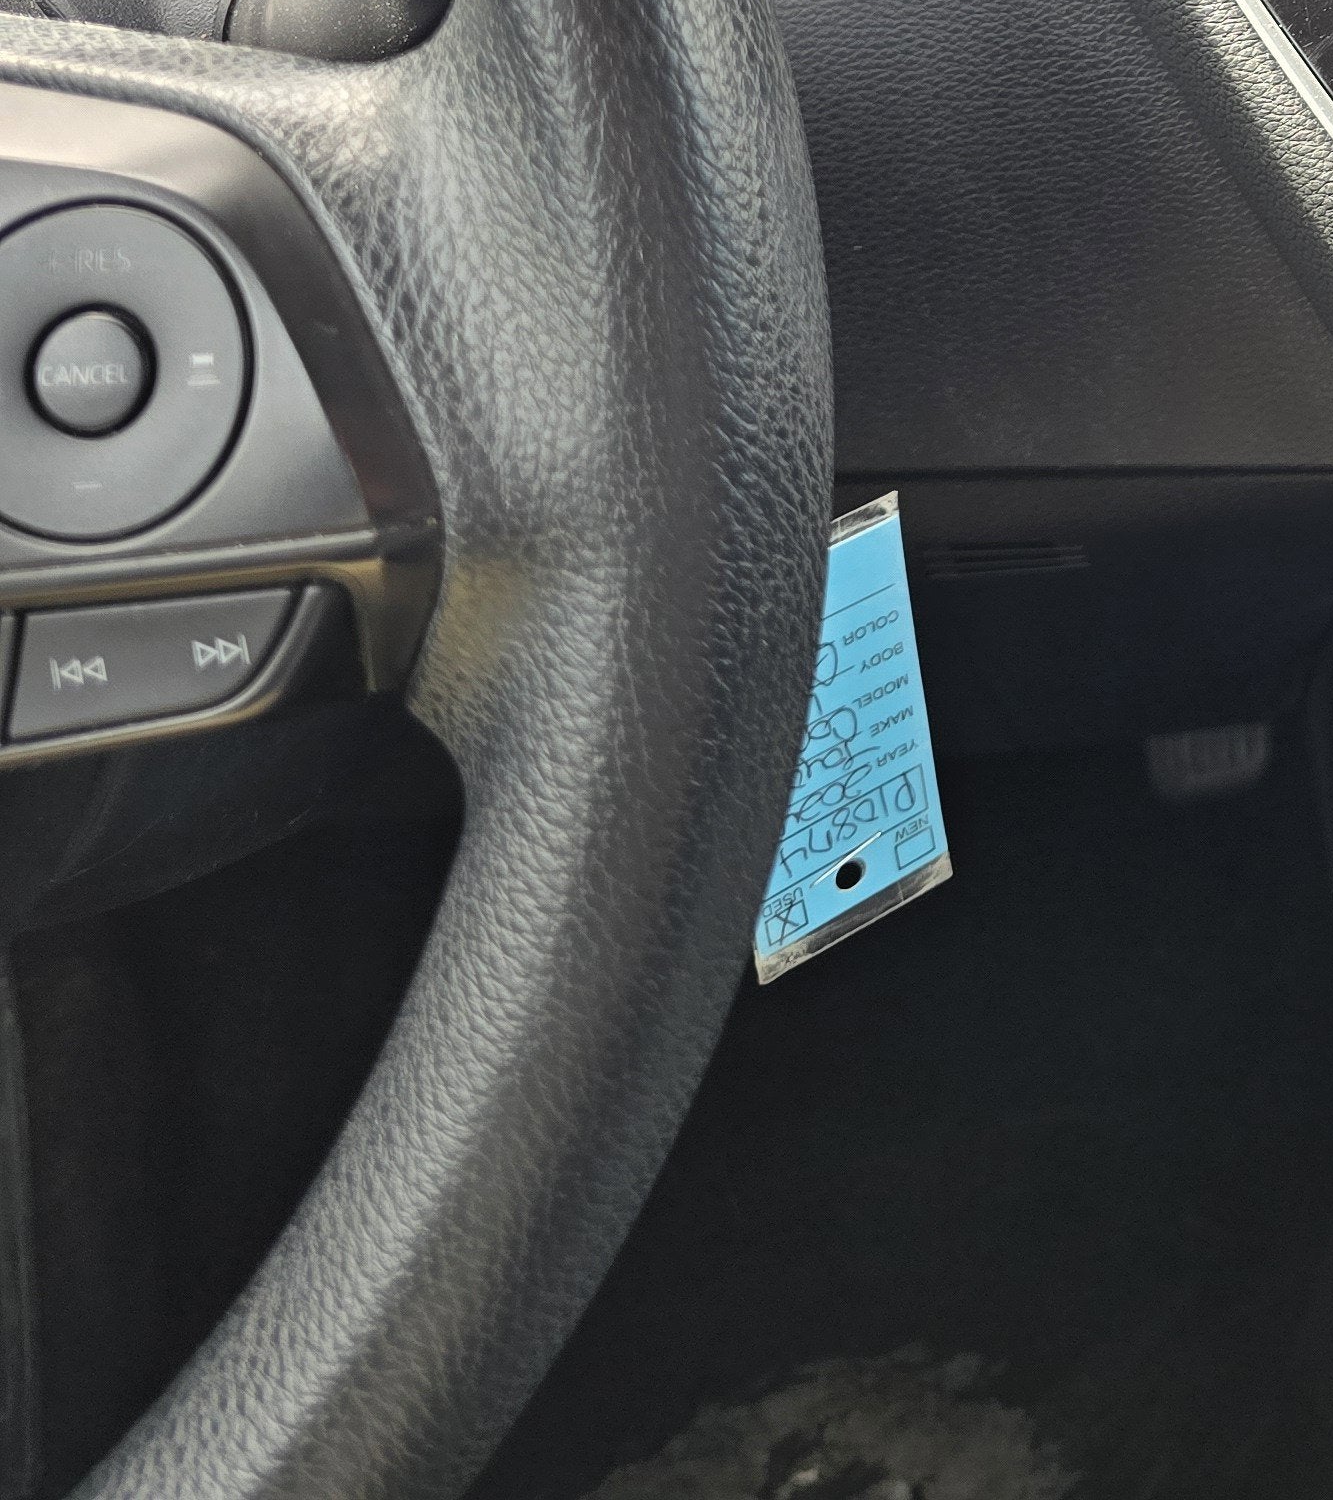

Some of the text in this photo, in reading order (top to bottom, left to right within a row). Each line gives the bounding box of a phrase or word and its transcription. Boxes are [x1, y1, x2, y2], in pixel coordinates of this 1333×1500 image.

[40, 361, 128, 387] CANCEL
[841, 608, 900, 647] COLOR
[859, 641, 904, 675] BODY
[858, 673, 909, 711] MODEL
[870, 705, 914, 738] MAKE
[876, 738, 918, 770] YEAR
[895, 814, 930, 842] NEW
